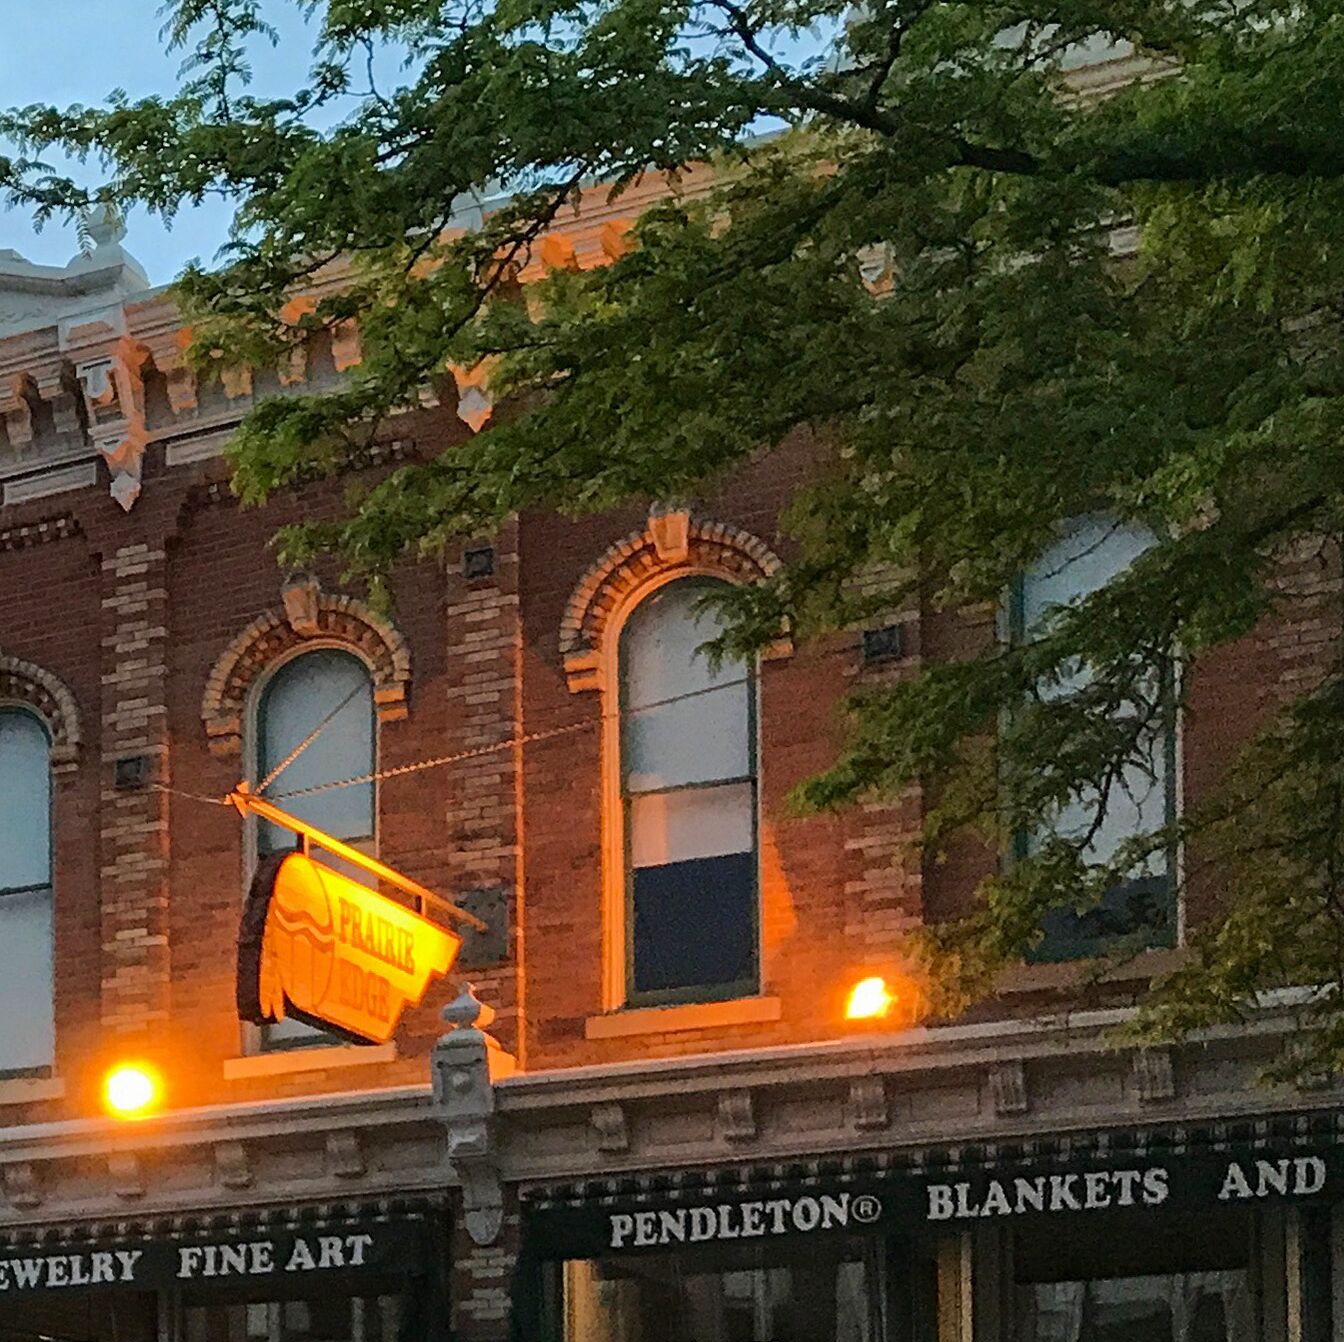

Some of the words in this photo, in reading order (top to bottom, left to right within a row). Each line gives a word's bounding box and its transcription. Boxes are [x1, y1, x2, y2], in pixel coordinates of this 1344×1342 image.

[338, 896, 415, 976] PRAIRIE
[926, 1167, 1170, 1222] BLANKETS
[1217, 1156, 1327, 1200] AND
[175, 1242, 275, 1279] FINE
[283, 1234, 374, 1272] ART
